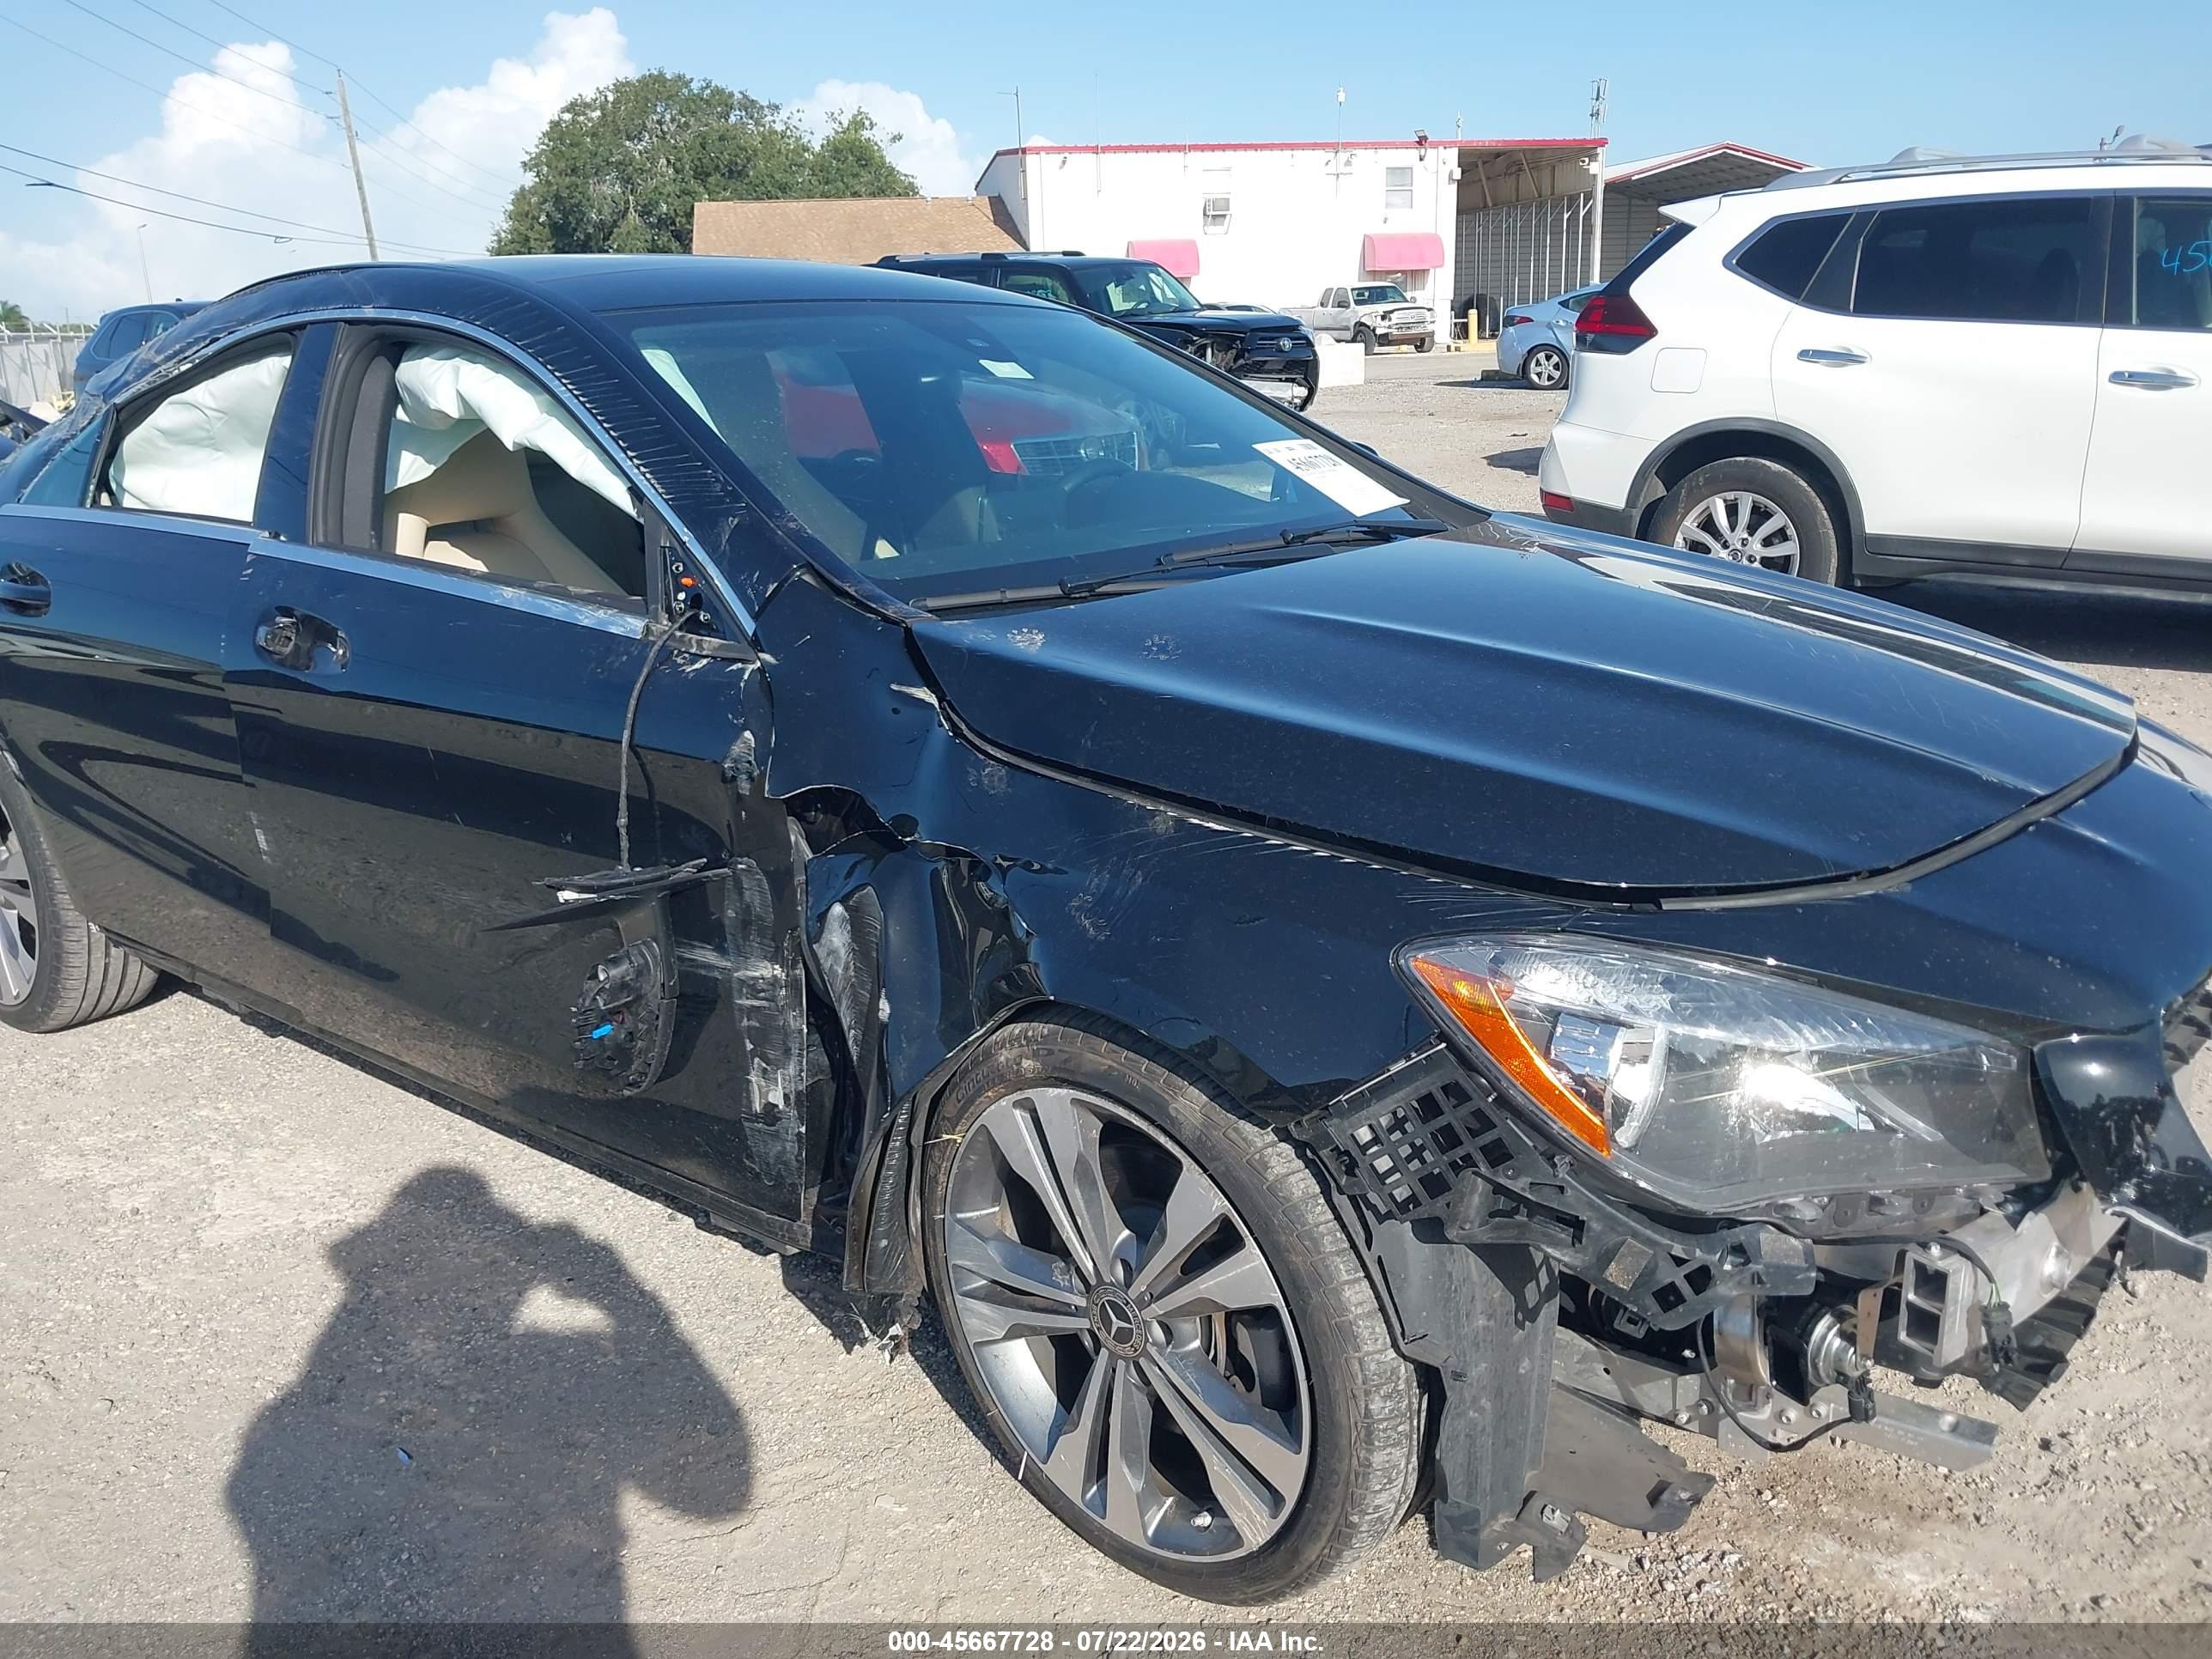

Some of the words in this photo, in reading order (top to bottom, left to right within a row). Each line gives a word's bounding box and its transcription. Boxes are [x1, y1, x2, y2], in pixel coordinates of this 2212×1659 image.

[2162, 240, 2212, 275] 45
[1091, 1304, 1101, 1328] BENZ
[1126, 1304, 1142, 1350] MERCEDES
